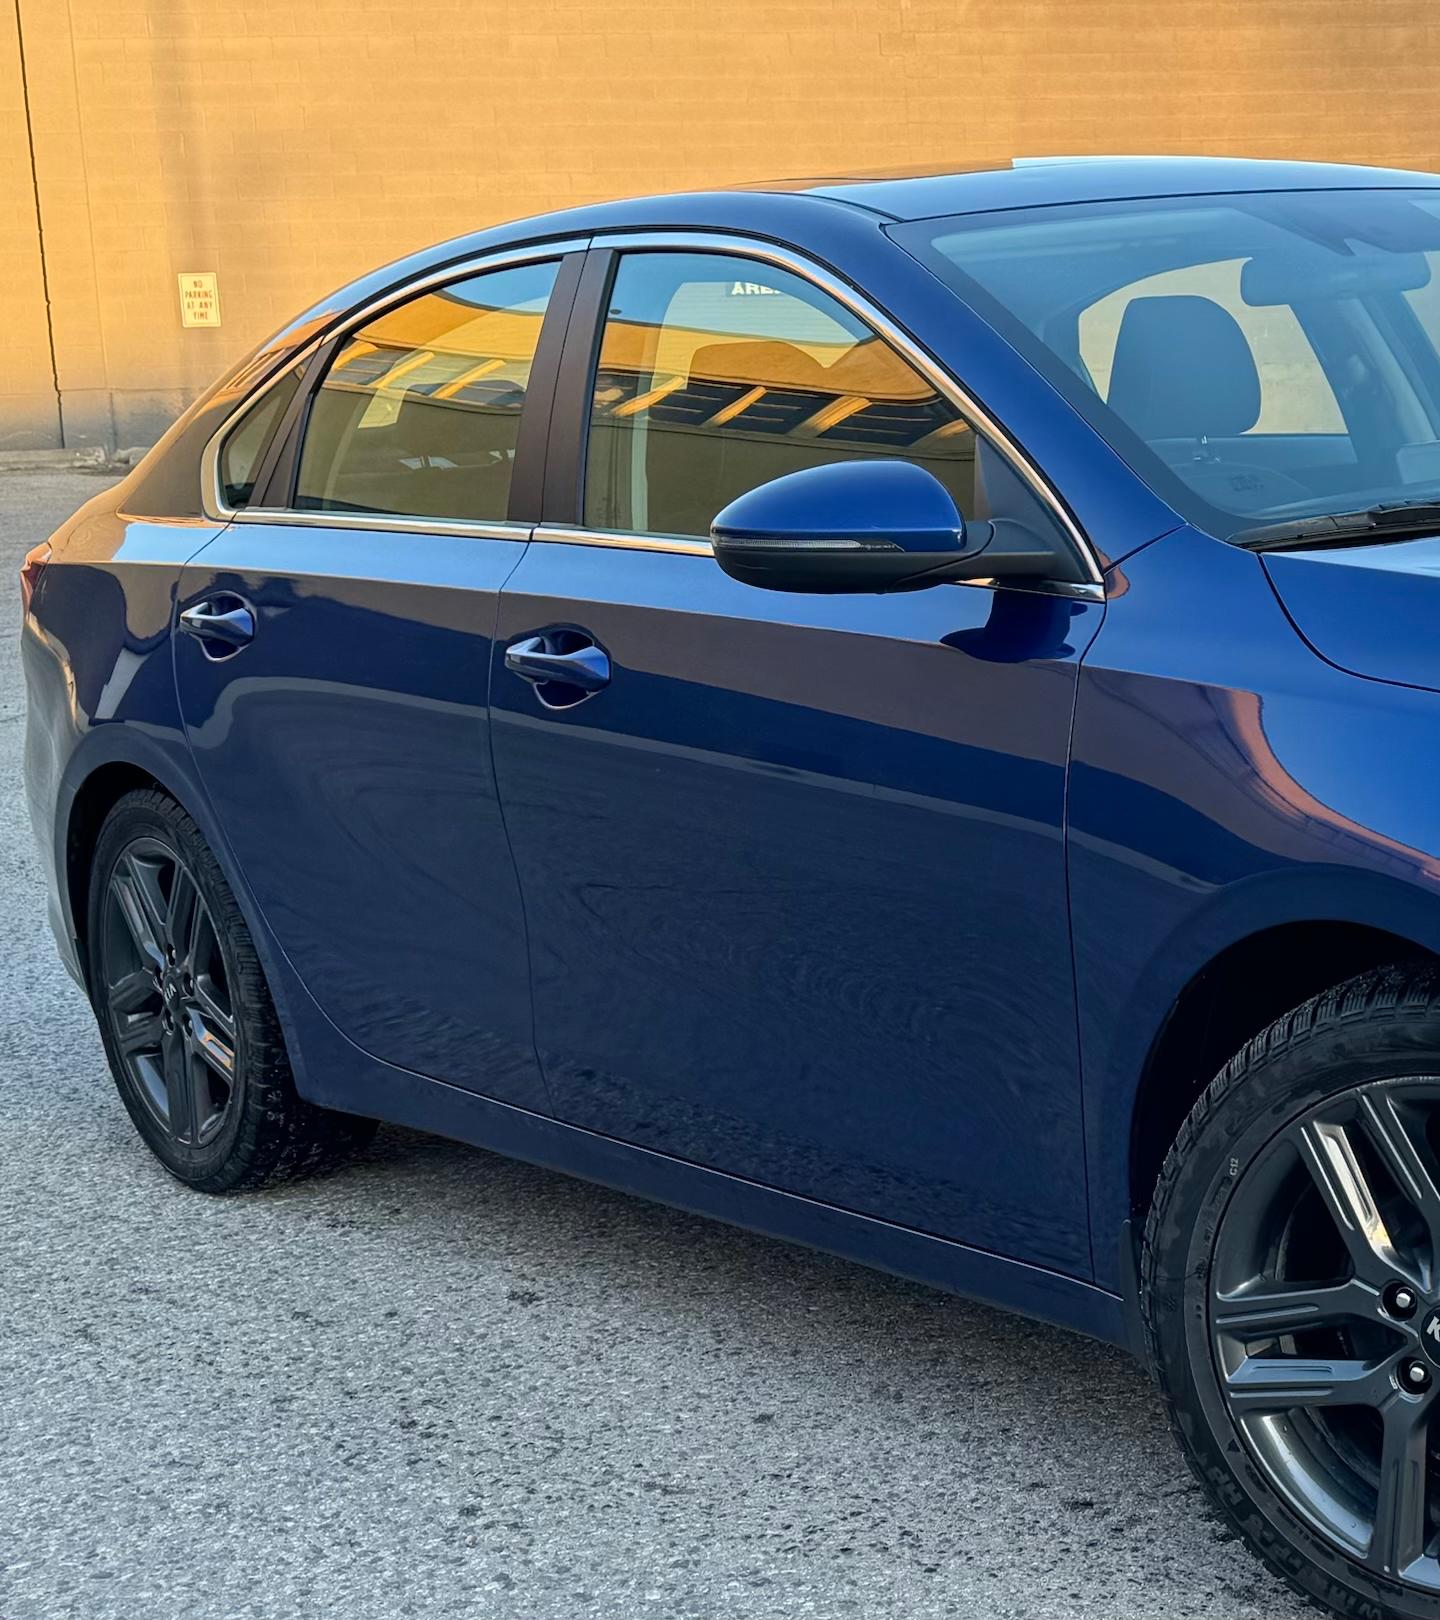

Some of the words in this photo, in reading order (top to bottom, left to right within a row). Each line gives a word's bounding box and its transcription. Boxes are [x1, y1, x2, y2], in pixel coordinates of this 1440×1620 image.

[193, 280, 203, 289] NO
[185, 290, 213, 299] PARKING
[187, 301, 195, 309] AT
[199, 301, 213, 309] ANY
[193, 311, 208, 320] TIME
